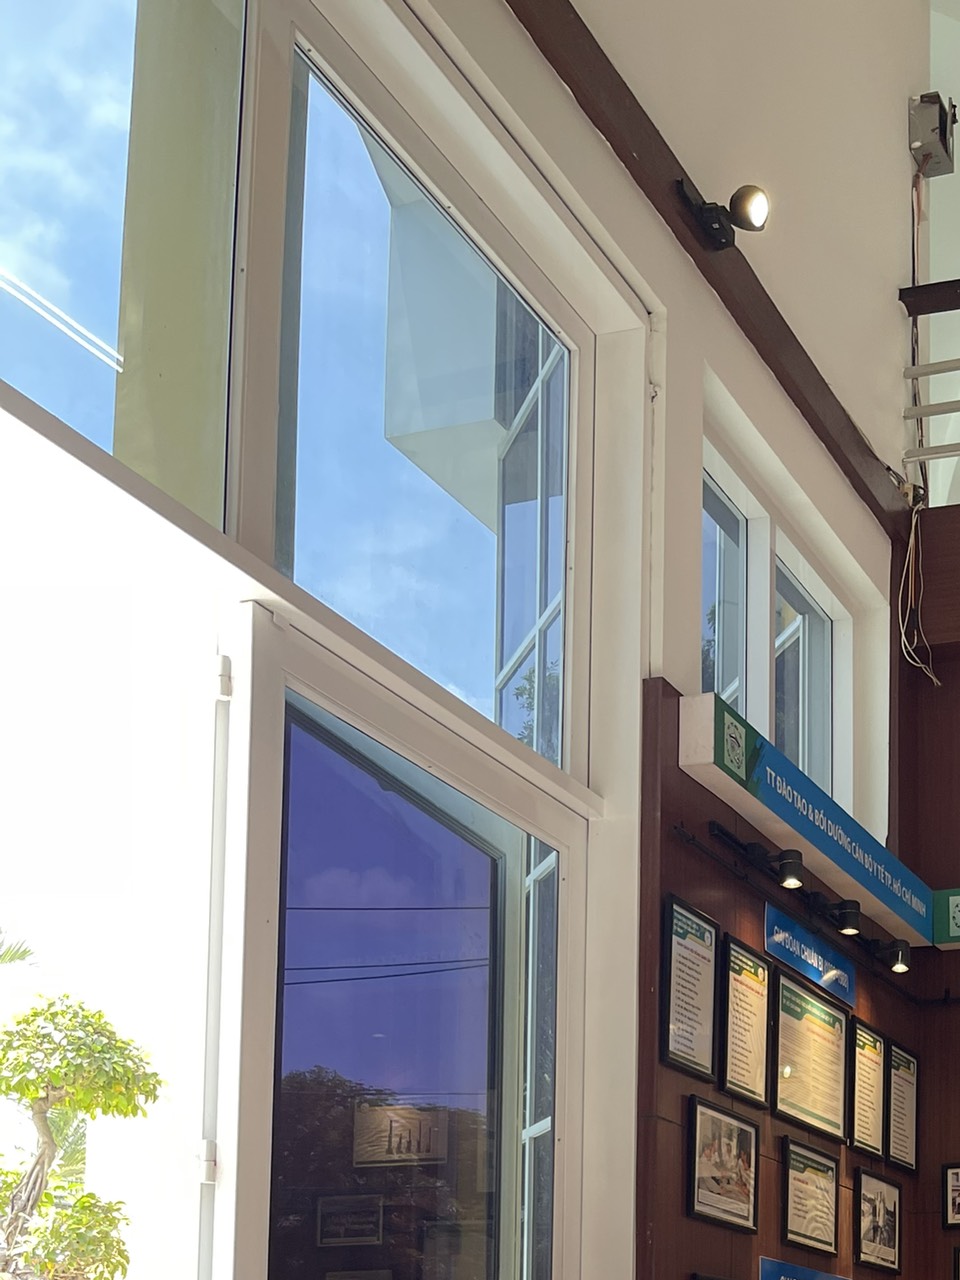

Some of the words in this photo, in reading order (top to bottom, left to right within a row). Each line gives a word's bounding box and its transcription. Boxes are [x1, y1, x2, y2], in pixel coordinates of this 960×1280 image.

[766, 766, 776, 788] TT
[776, 777, 793, 804] ĐÀO
[792, 789, 808, 816] TẠO
[808, 804, 814, 822] &
[911, 894, 926, 918] MINH
